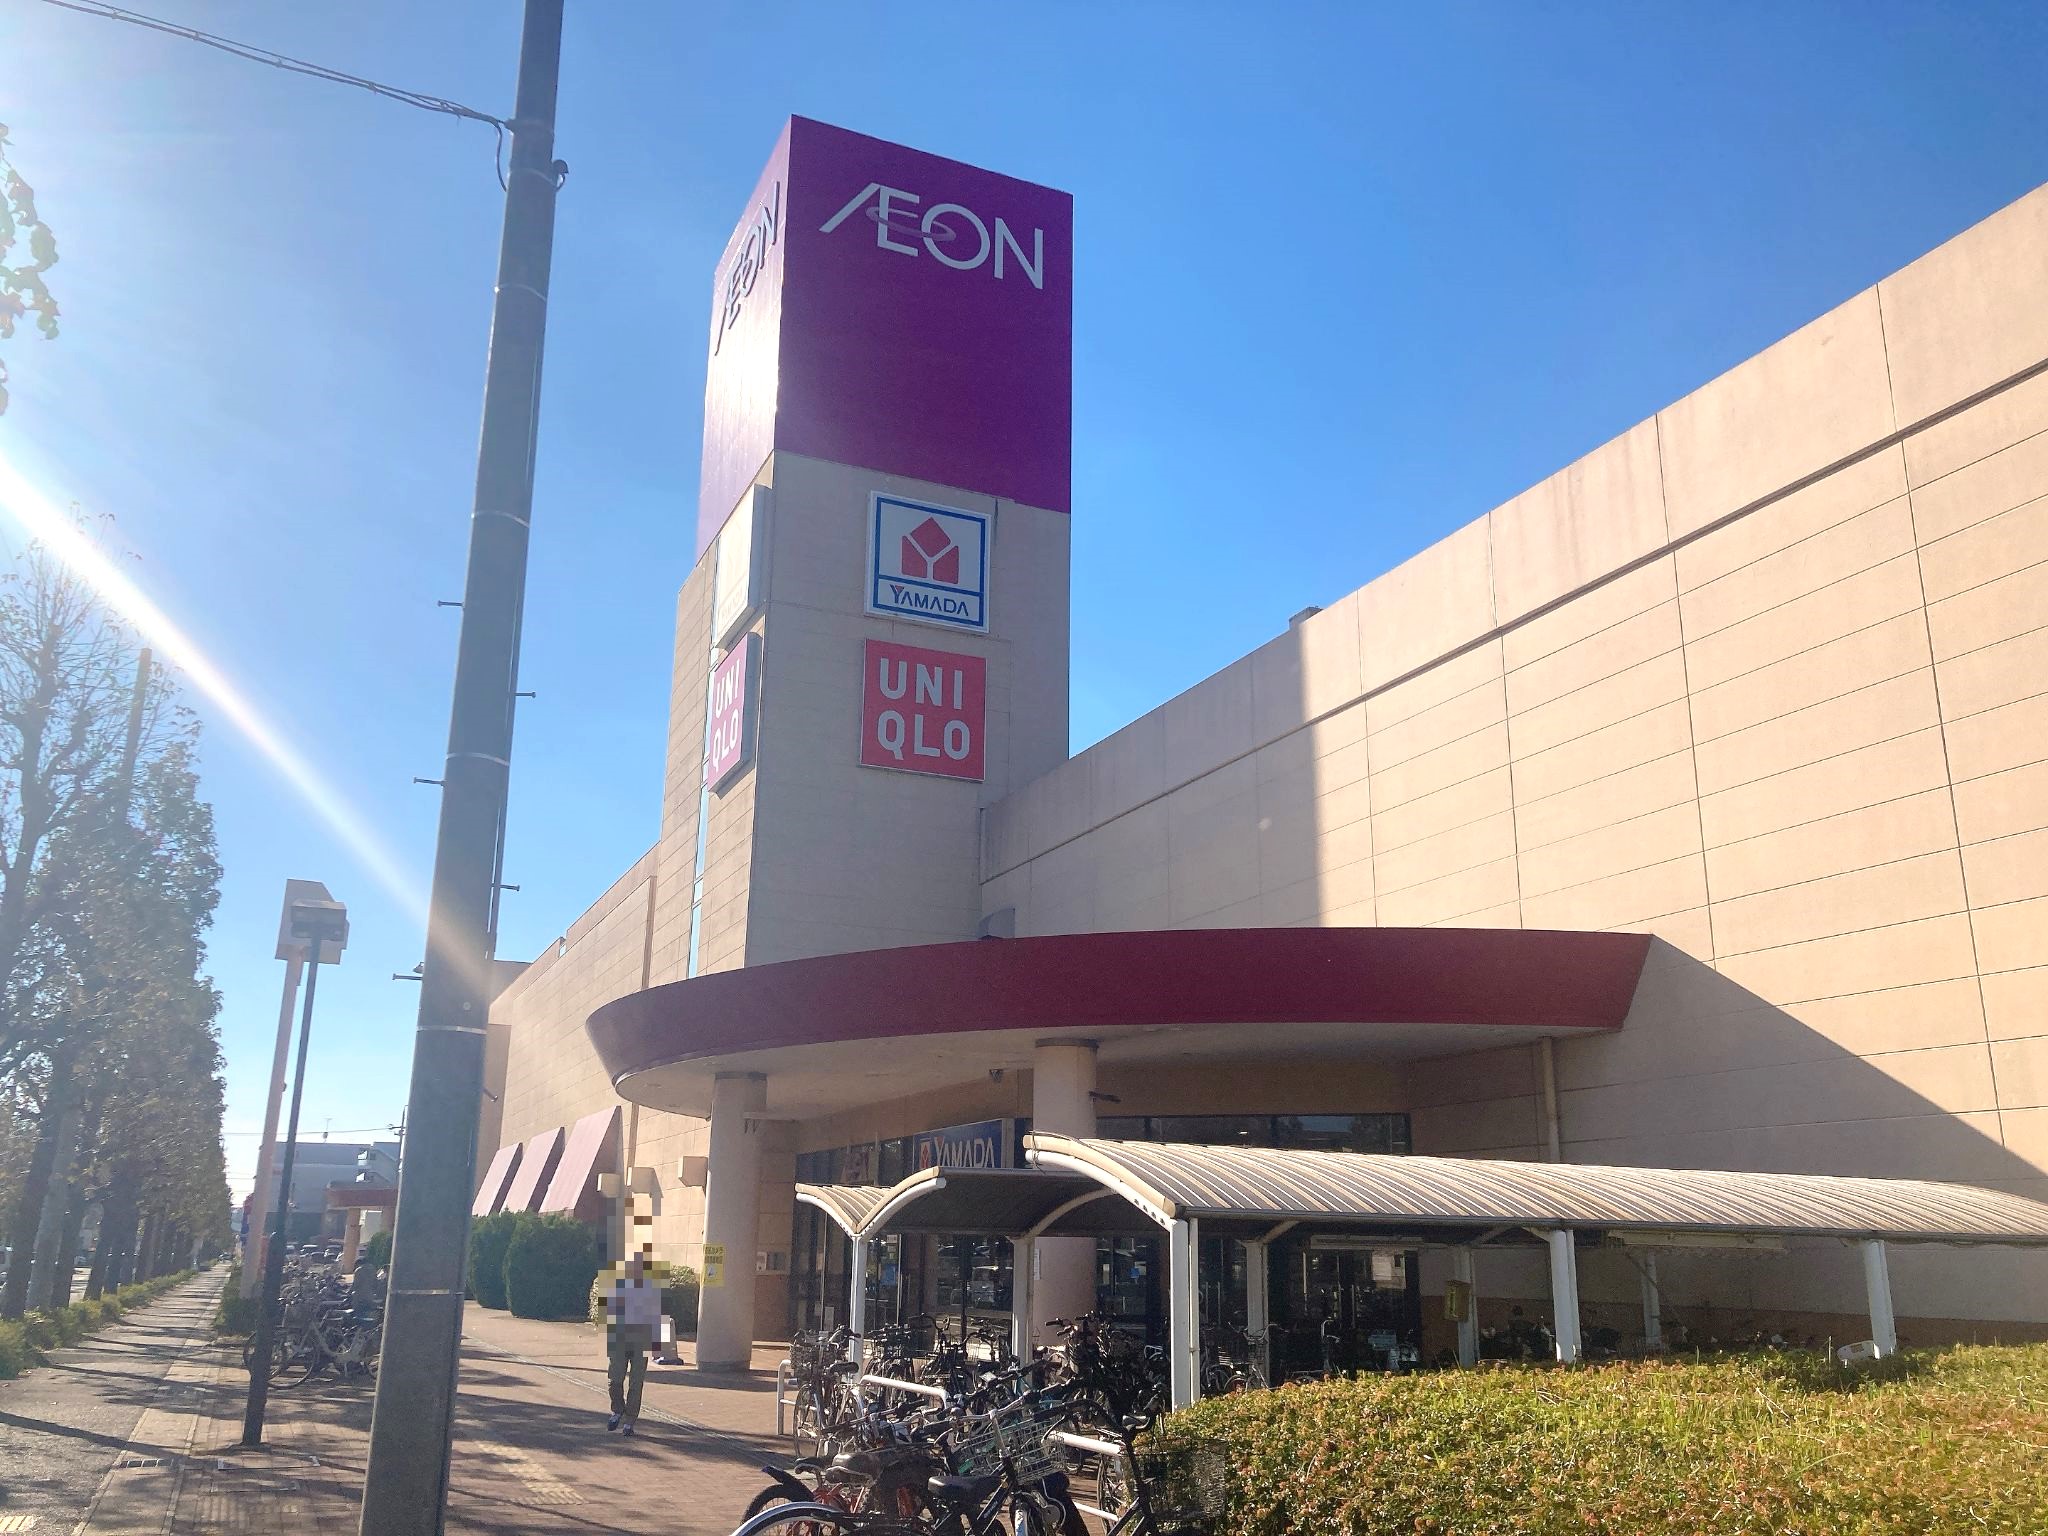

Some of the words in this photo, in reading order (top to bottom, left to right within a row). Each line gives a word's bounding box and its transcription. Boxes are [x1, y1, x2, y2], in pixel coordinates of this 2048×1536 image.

[889, 584, 969, 617] YAMADA
[715, 658, 740, 719] UNI
[880, 657, 963, 710] UNI
[712, 708, 739, 773] QLO
[877, 709, 971, 761] QLO
[934, 1136, 995, 1169] YAMADA
